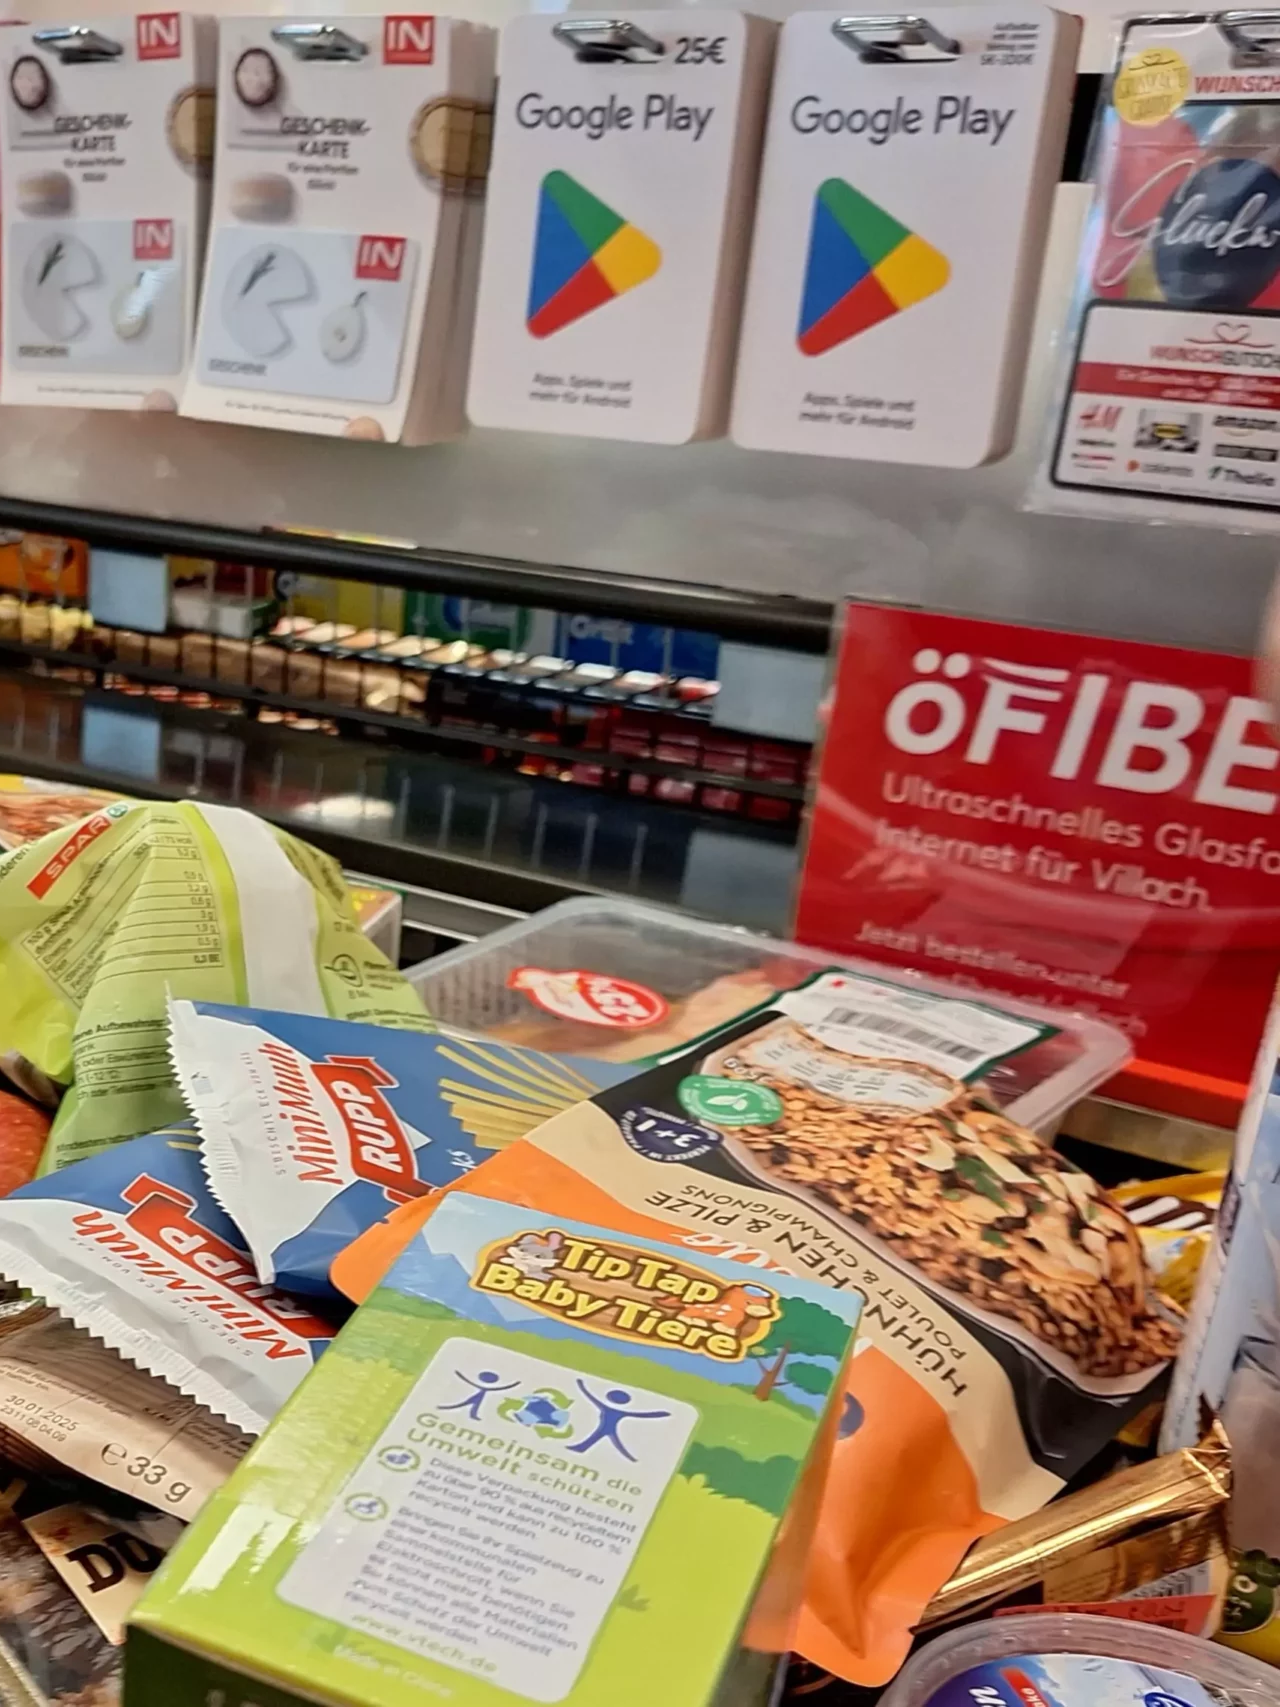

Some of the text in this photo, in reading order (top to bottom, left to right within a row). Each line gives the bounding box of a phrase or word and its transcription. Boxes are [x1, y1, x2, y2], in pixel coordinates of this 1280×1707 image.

[139, 17, 178, 48] IN
[386, 20, 432, 52] IN
[674, 37, 727, 64] 25€
[515, 92, 715, 142] Google Play
[790, 94, 1018, 147] Google Play
[71, 135, 116, 152] KARTE
[297, 140, 351, 160] KARTE
[136, 224, 172, 249] IN
[360, 241, 402, 271] IN
[799, 411, 915, 431] mehr für Android
[843, 393, 884, 410] Spiele
[887, 400, 915, 413] und
[883, 771, 1145, 850] Ultraschnelles
[47, 814, 110, 882] SPAR
[875, 817, 1019, 874] Internet
[1027, 844, 1083, 886] für
[331, 1079, 405, 1174] RUPP
[644, 1189, 774, 1235] & PILZE
[678, 1182, 859, 1269] CHAMPIGNONS
[562, 1238, 721, 1308] Tip Tap
[477, 1262, 741, 1360] Baby Tiere
[861, 1270, 968, 1361] POULET &
[5, 1394, 80, 1433] 30.01.2025
[127, 1456, 193, 1504] 33 g
[406, 1428, 635, 1514] Umwelt schützen
[416, 1413, 643, 1497] Gemeinsam die
[407, 1488, 474, 1521] recycelt
[416, 1478, 470, 1504] Karton
[471, 1497, 506, 1516] und
[506, 1506, 548, 1530] kann
[549, 1523, 570, 1538] zu
[573, 1530, 606, 1550] 100
[422, 1469, 441, 1481] zu
[442, 1473, 479, 1492] über
[479, 1486, 502, 1501] 90
[519, 1500, 546, 1516] aus
[547, 1507, 633, 1546] recyceltem
[429, 1457, 638, 1535] Diese Verpackung besteht
